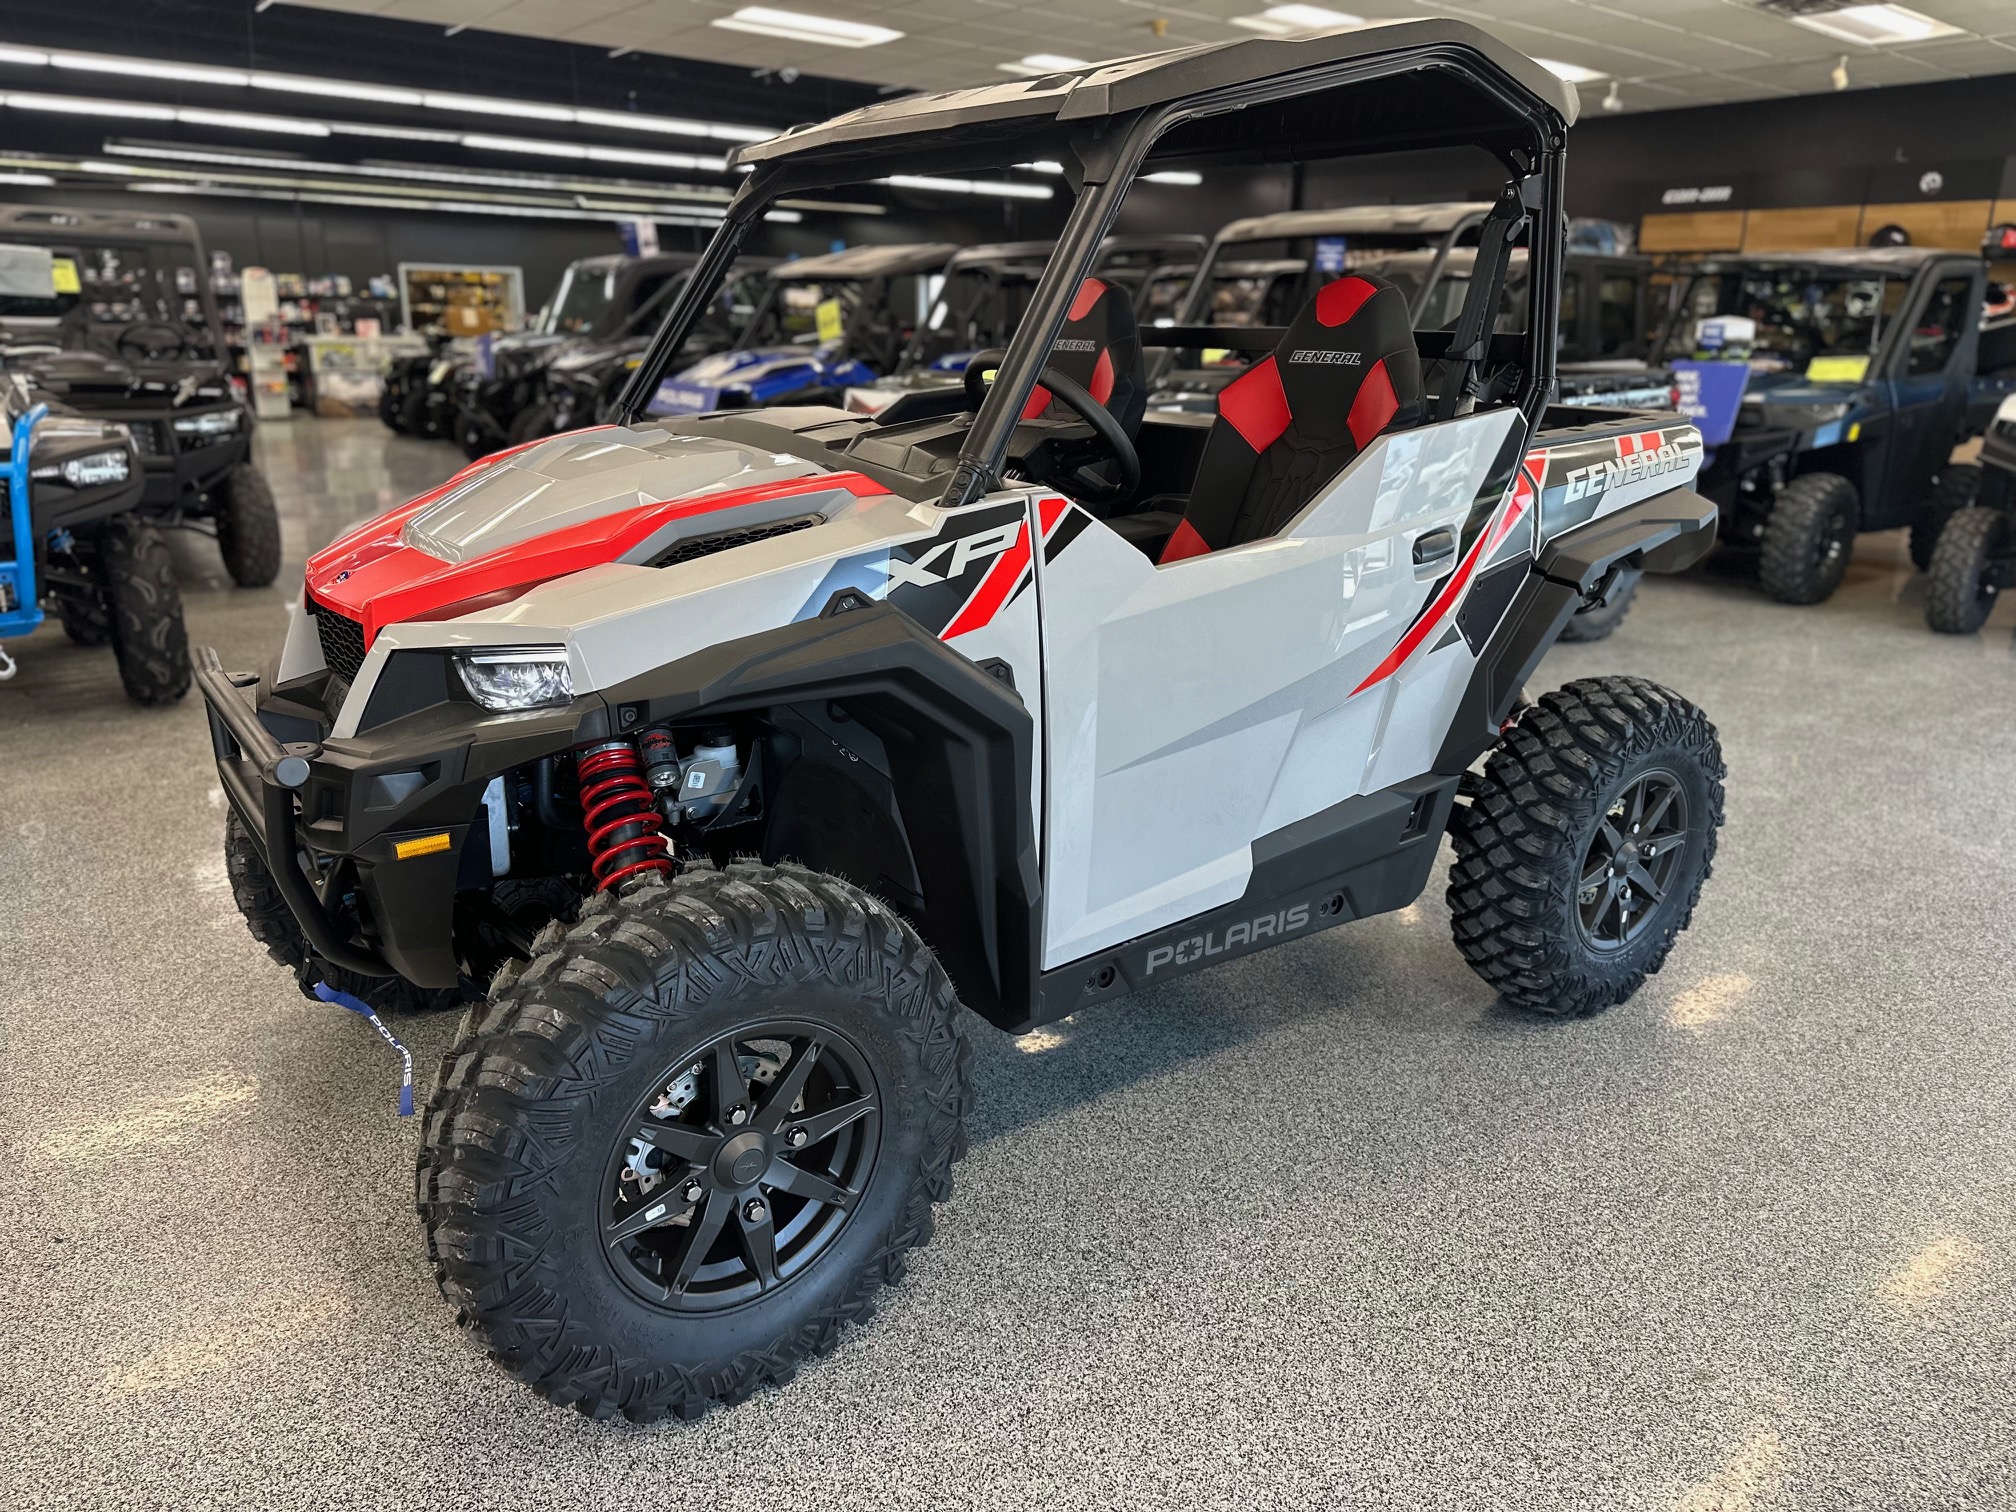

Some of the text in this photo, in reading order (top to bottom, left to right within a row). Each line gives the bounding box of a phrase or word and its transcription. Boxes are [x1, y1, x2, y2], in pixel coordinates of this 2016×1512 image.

[1052, 339, 1096, 352] ENERAL
[1289, 349, 1362, 366] GENERAL
[1563, 442, 1690, 505] GENERAL
[863, 518, 1024, 602] XP
[1145, 902, 1311, 976] POLARIS
[369, 1014, 412, 1087] POLARIS
